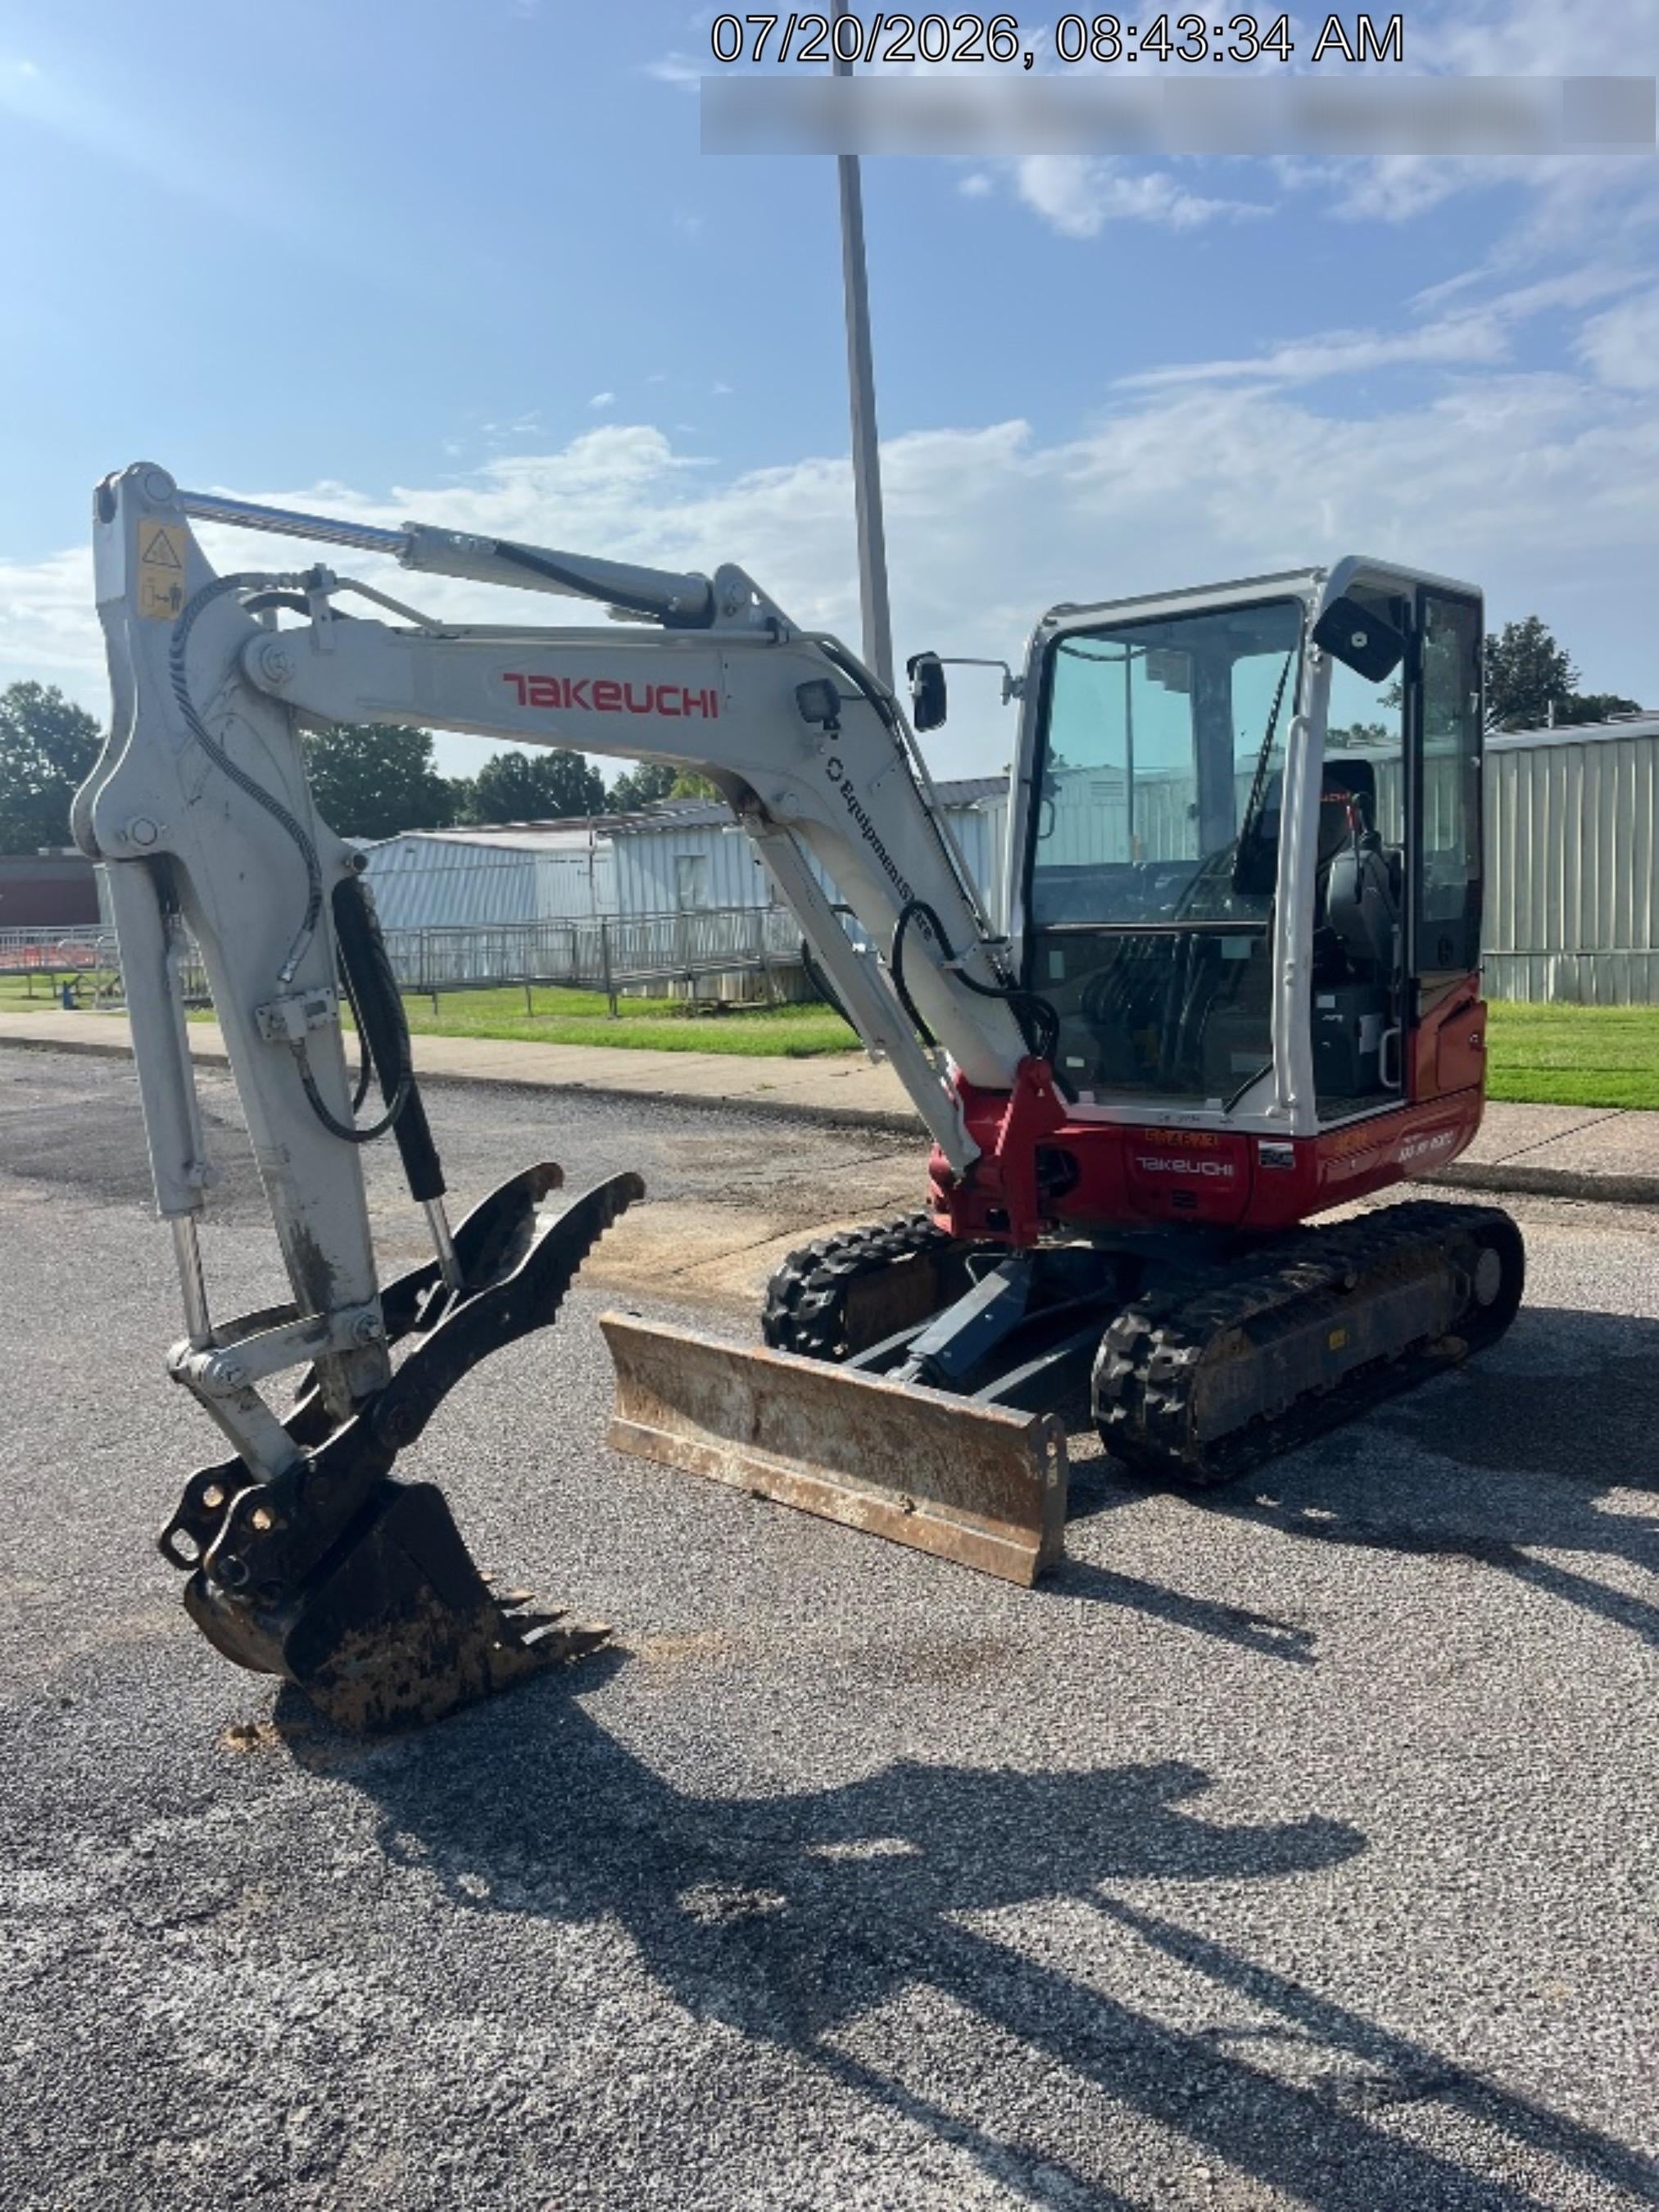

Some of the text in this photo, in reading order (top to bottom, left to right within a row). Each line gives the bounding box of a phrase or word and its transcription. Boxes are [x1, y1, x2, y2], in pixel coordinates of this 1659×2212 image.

[503, 673, 719, 718] TAKEUCHI
[839, 779, 932, 942] EquipmentSare
[1135, 1157, 1235, 1176] TAKEUCHI
